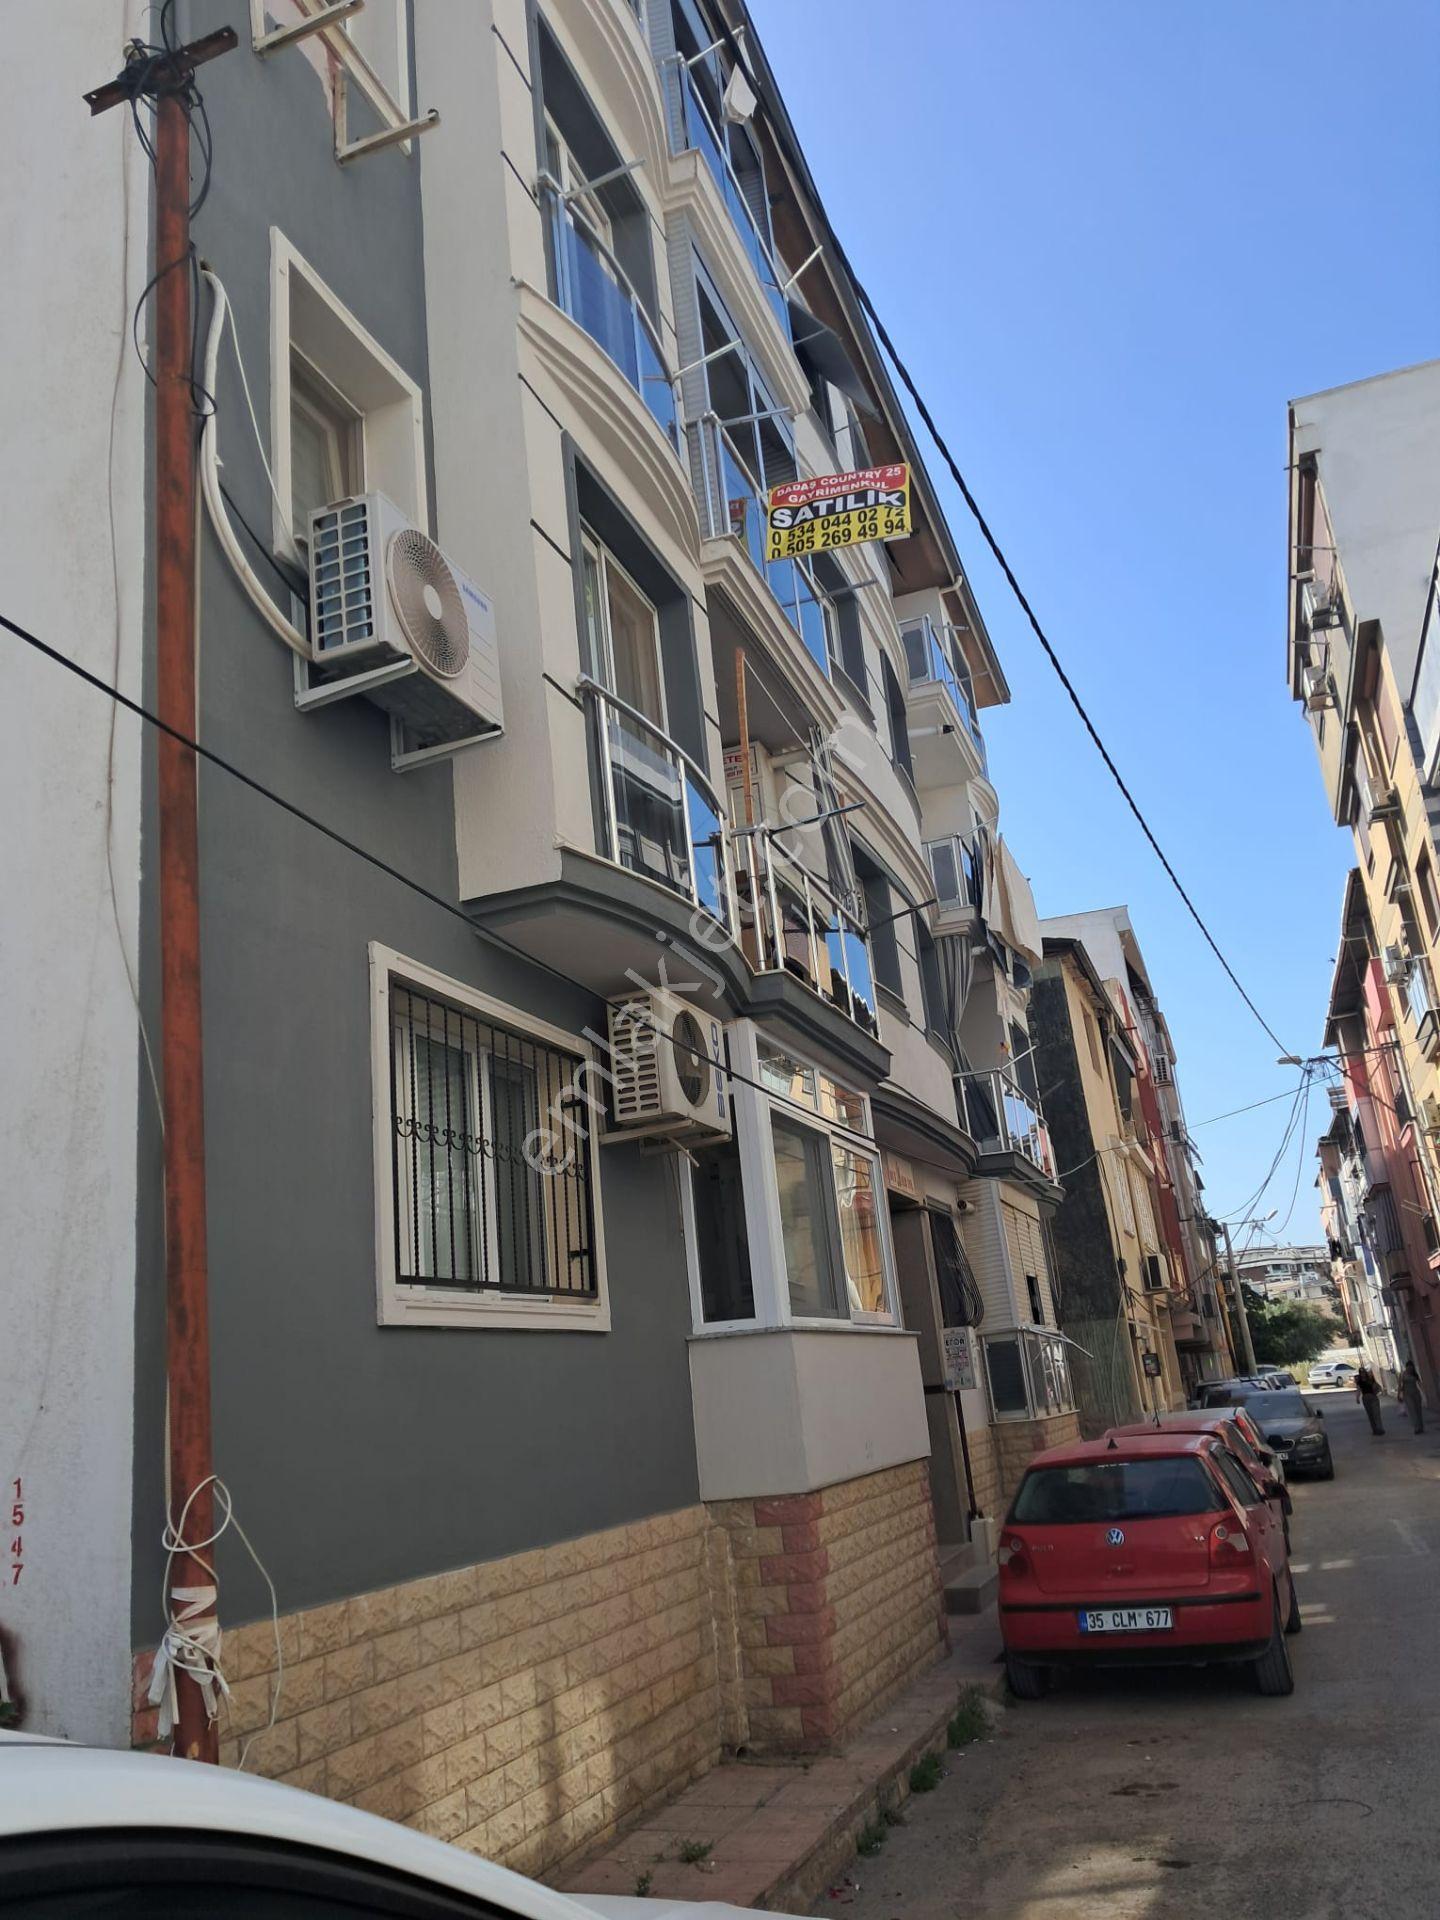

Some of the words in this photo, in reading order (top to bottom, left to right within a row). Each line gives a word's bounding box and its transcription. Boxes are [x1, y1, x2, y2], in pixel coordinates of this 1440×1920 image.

[777, 480, 816, 497] DADAŞ
[820, 469, 882, 486] COUNTRY
[885, 466, 901, 477] 25
[788, 480, 889, 503] GAYRİMENKUL
[772, 490, 903, 528] SATILIK
[772, 531, 782, 546] 0
[787, 522, 815, 542] 534
[821, 514, 852, 531] 044
[858, 508, 878, 523] 02
[884, 506, 905, 518] 72
[771, 547, 781, 559] 0
[786, 535, 815, 556] 505
[821, 528, 852, 547] 269
[857, 524, 878, 538] 49
[884, 518, 905, 534] 94
[1088, 1612, 1104, 1629] 35
[1112, 1610, 1138, 1628] CLM
[1146, 1609, 1170, 1626] 677
